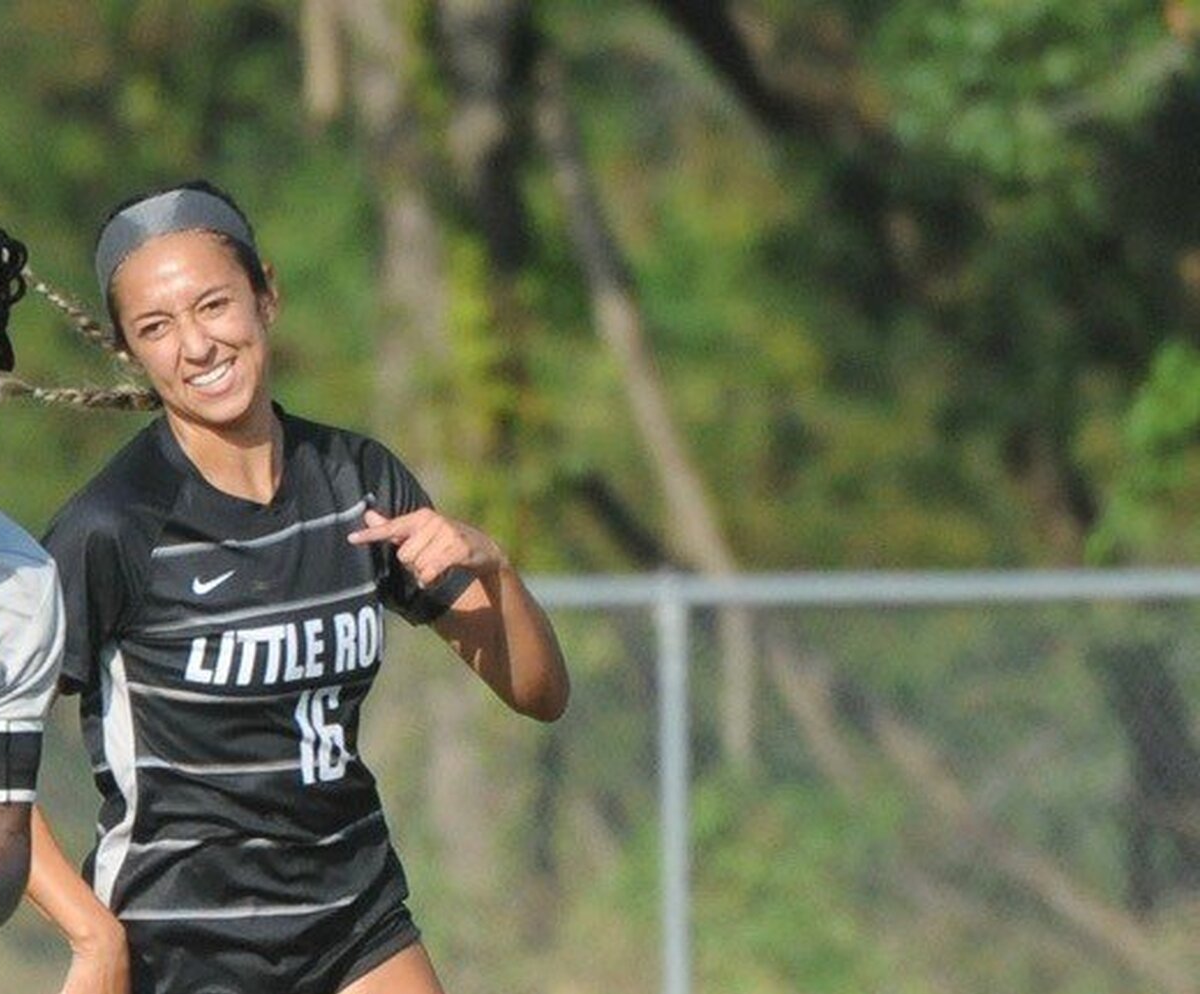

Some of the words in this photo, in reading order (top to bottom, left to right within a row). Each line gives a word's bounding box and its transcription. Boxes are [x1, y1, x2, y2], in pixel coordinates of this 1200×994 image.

[185, 618, 324, 686] LITTLE
[333, 602, 383, 674] RO
[295, 685, 348, 785] 16
